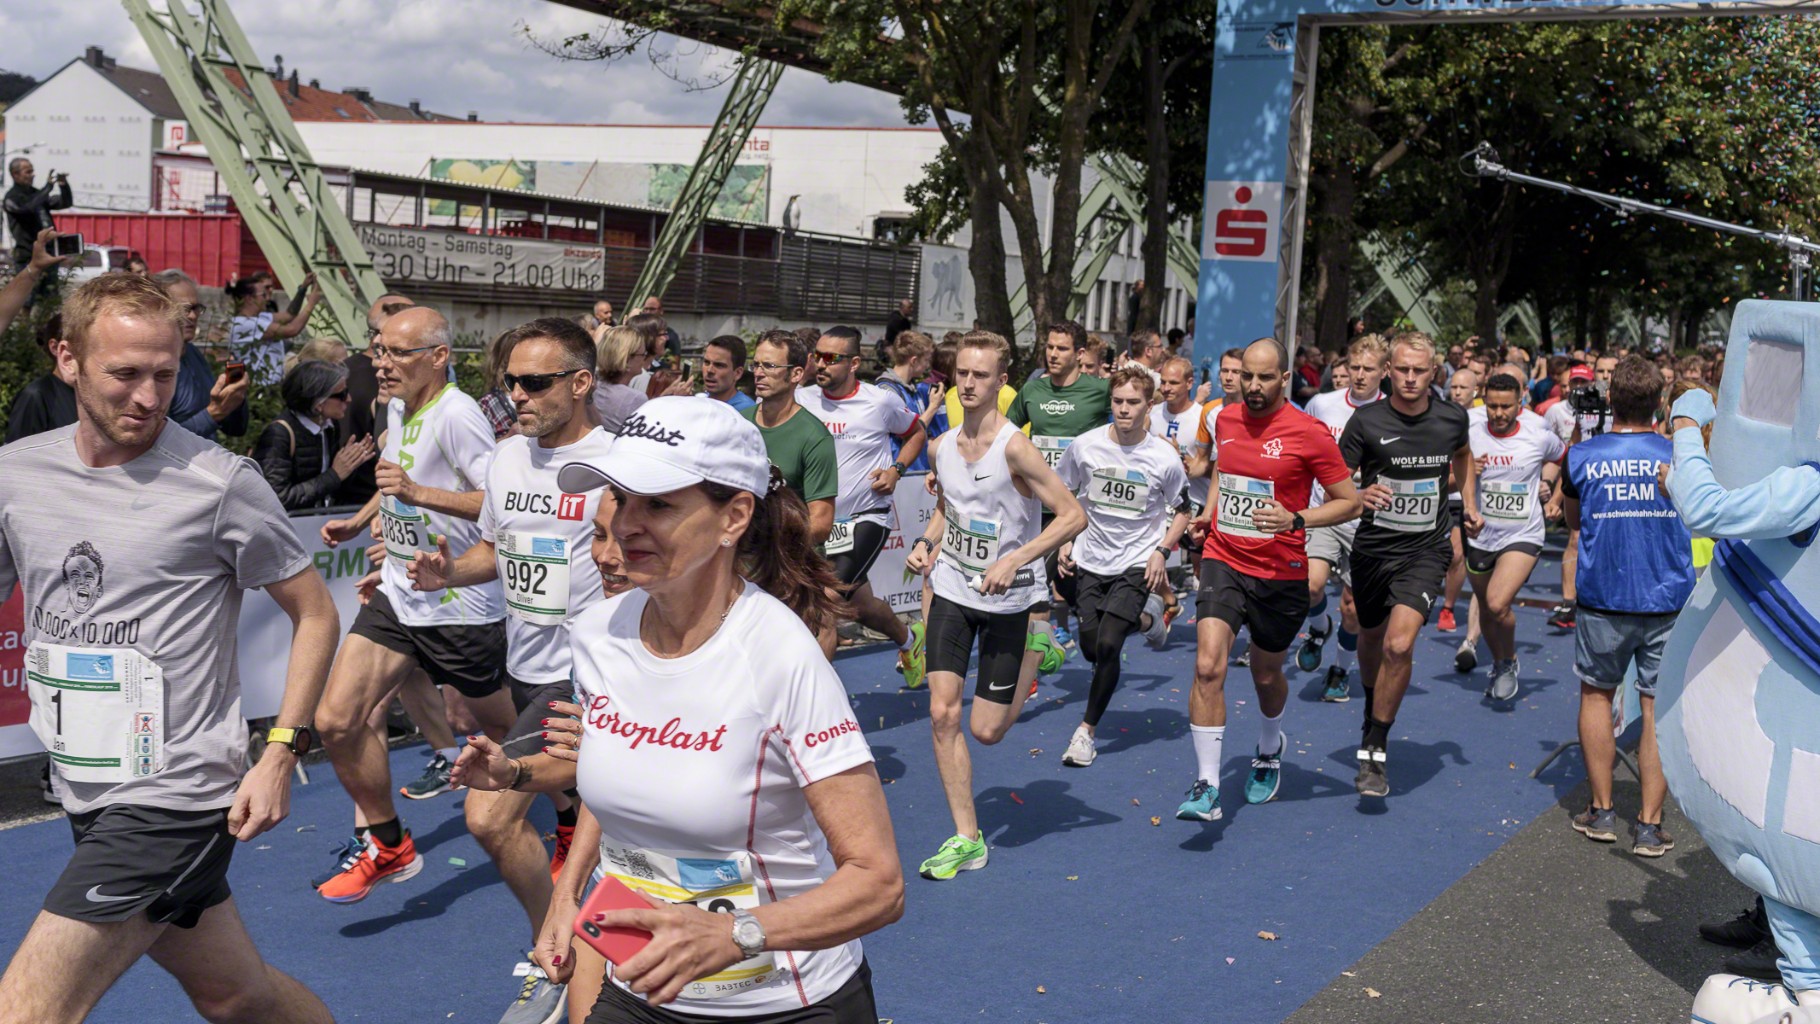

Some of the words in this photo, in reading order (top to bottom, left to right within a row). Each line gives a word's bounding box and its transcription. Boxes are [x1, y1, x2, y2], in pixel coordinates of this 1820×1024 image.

[361, 228, 426, 253] Montag
[445, 234, 514, 259] Samstag
[424, 256, 471, 282] Uhr
[493, 262, 554, 288] 21.00
[562, 266, 601, 290] Uhr
[1040, 403, 1076, 412] VORWERK
[1391, 457, 1418, 465] WOLF
[1418, 456, 1425, 464] &
[1586, 459, 1660, 480] KAMERA
[1101, 481, 1136, 501] 496
[1486, 494, 1524, 511] 2029
[1604, 483, 1655, 501] TEAM
[382, 514, 419, 547] 3835
[947, 524, 989, 560] 5915
[507, 559, 548, 595] 992
[51, 690, 62, 735] 1
[588, 694, 728, 752] Coroplast
